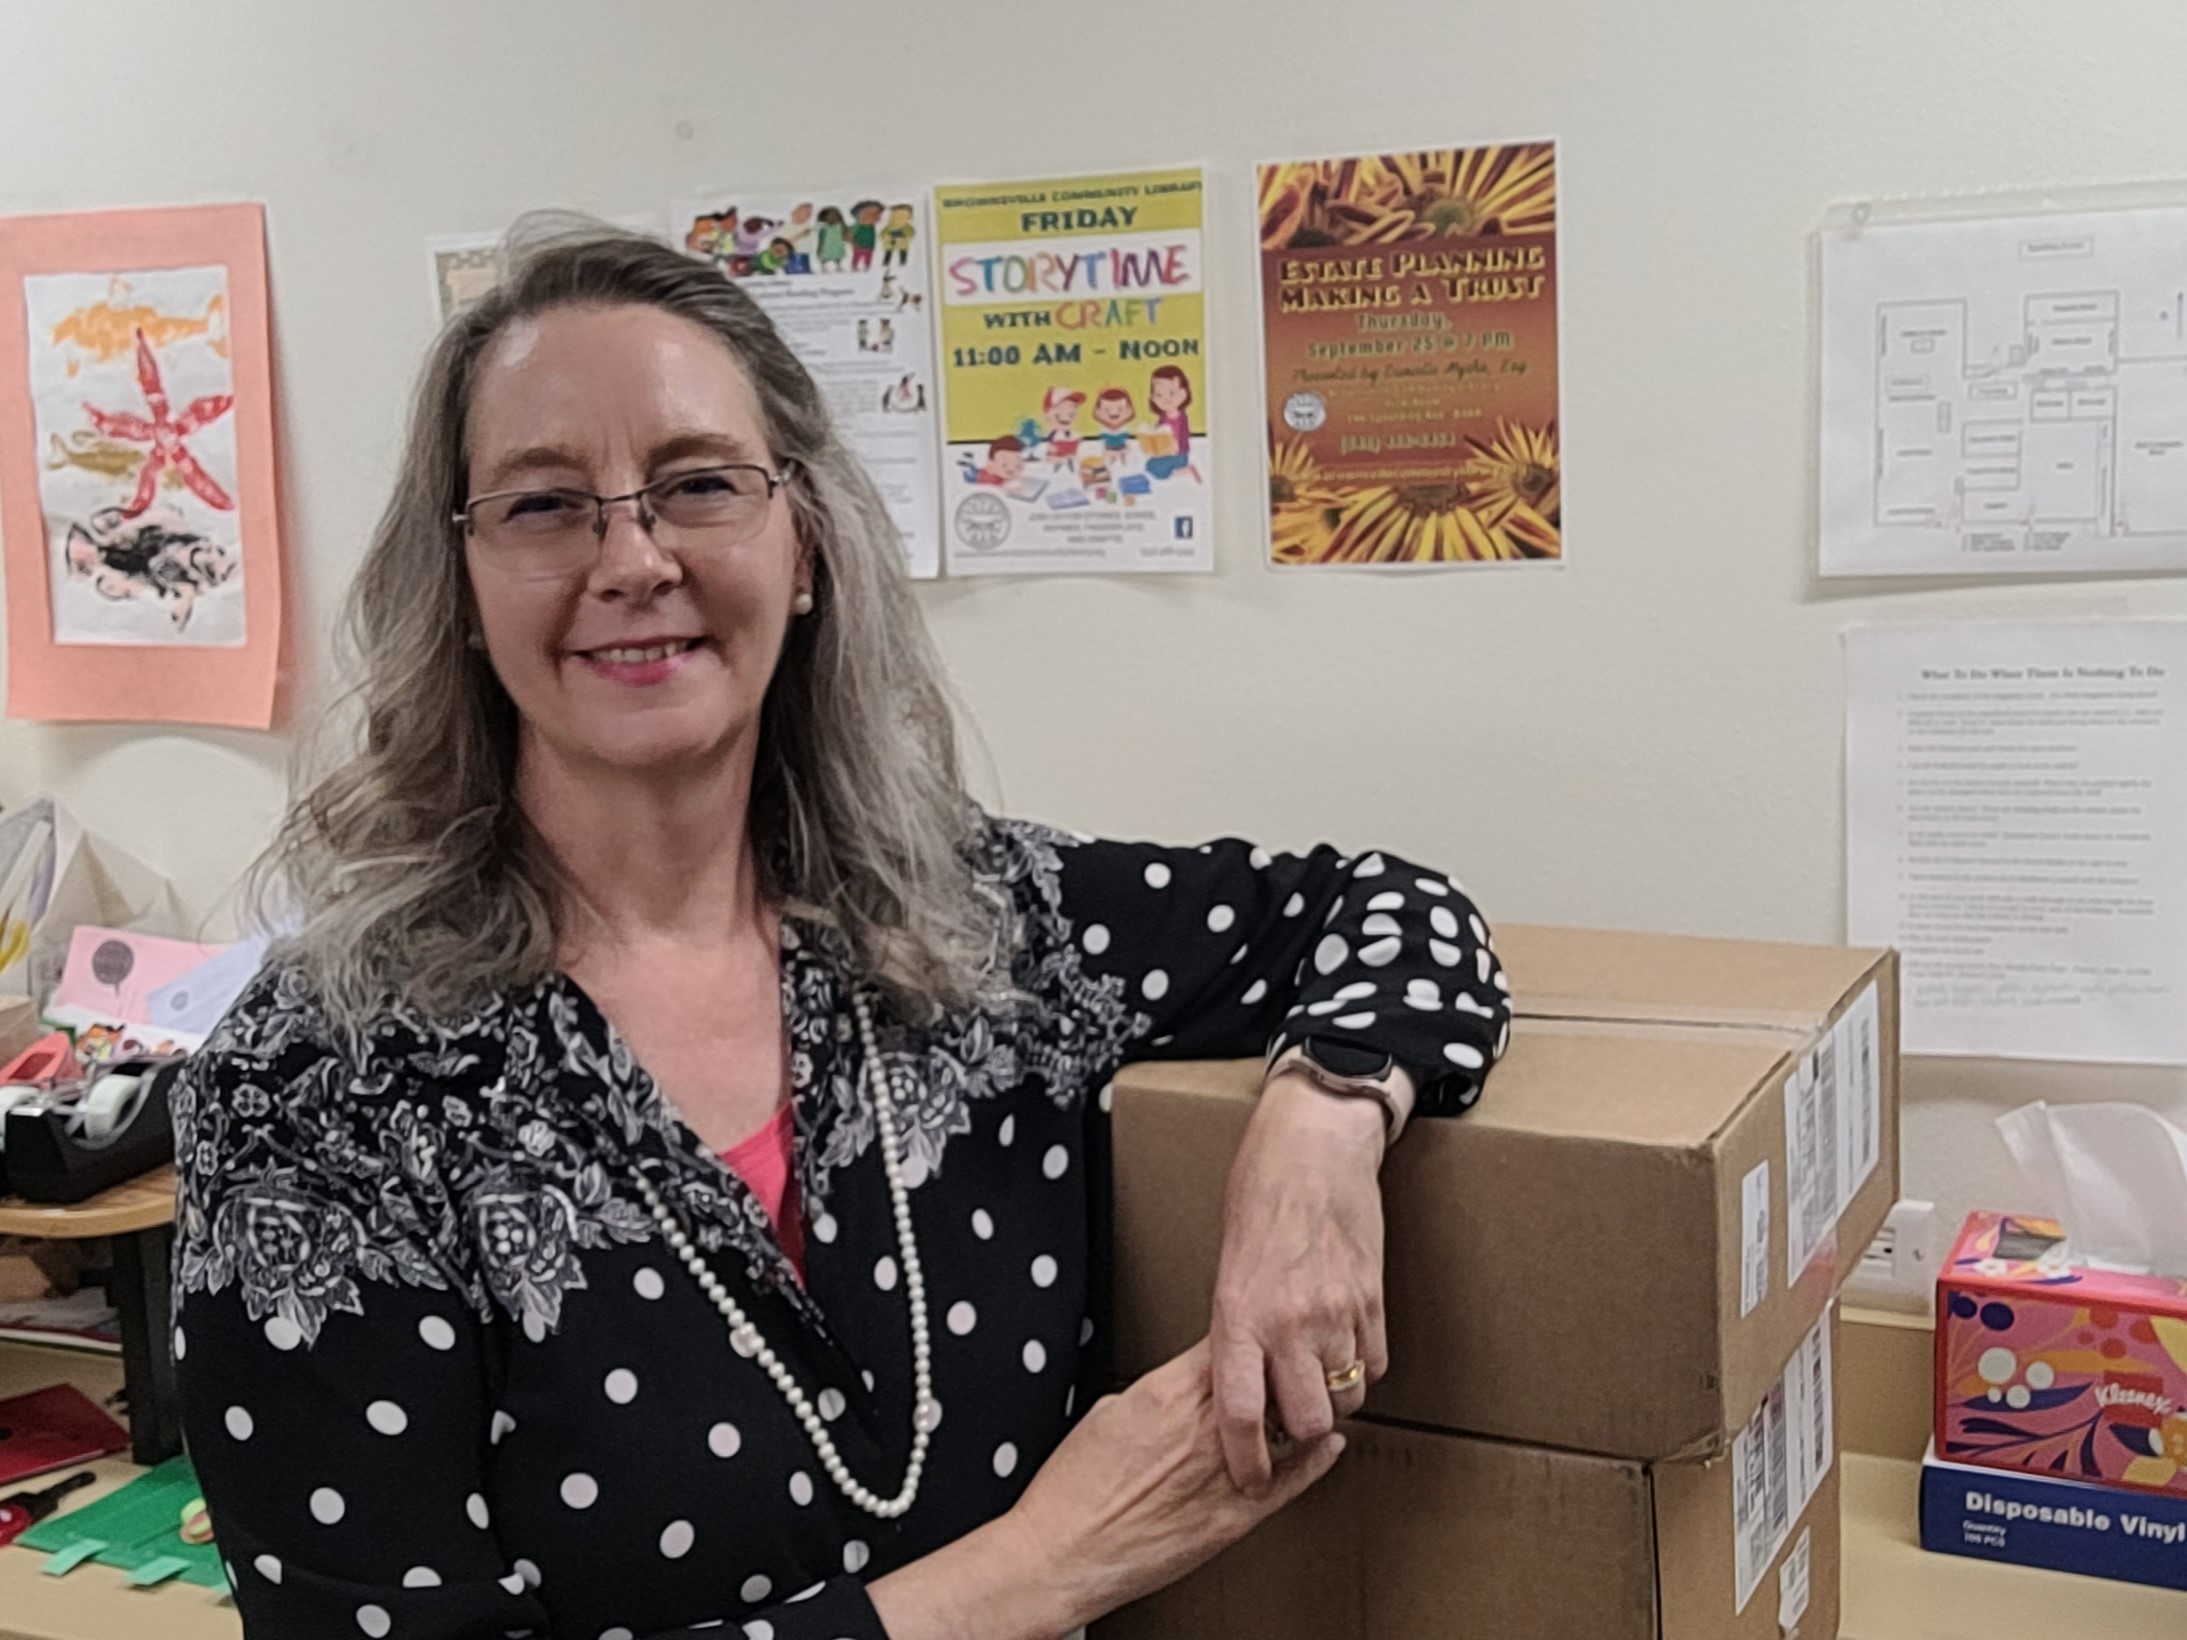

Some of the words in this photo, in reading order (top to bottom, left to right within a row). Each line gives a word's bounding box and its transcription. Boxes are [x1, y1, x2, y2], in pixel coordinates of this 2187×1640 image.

[1052, 186, 1139, 202] COMMUNITY
[1021, 205, 1138, 232] FRIDAY
[948, 244, 1190, 296] STORYTIME
[1411, 282, 1432, 305] A
[983, 309, 1051, 329] WITH
[1055, 297, 1163, 330] CRAFT
[954, 345, 1020, 367] 11:00
[1032, 343, 1081, 365] AM
[1119, 338, 1198, 360] NOON
[1308, 339, 1401, 360] September
[1413, 335, 1434, 352] 25
[1921, 669, 1949, 680] What
[1954, 669, 1967, 680] To
[1970, 669, 1987, 680] Do
[1991, 668, 2022, 680] When
[2076, 667, 2124, 680] Nothing
[2130, 666, 2143, 678] To
[2146, 666, 2165, 677] Do
[2094, 1382, 2172, 1416] Kleenex
[1965, 1491, 2110, 1531] Disposable
[2119, 1513, 2186, 1546] Vinyl
